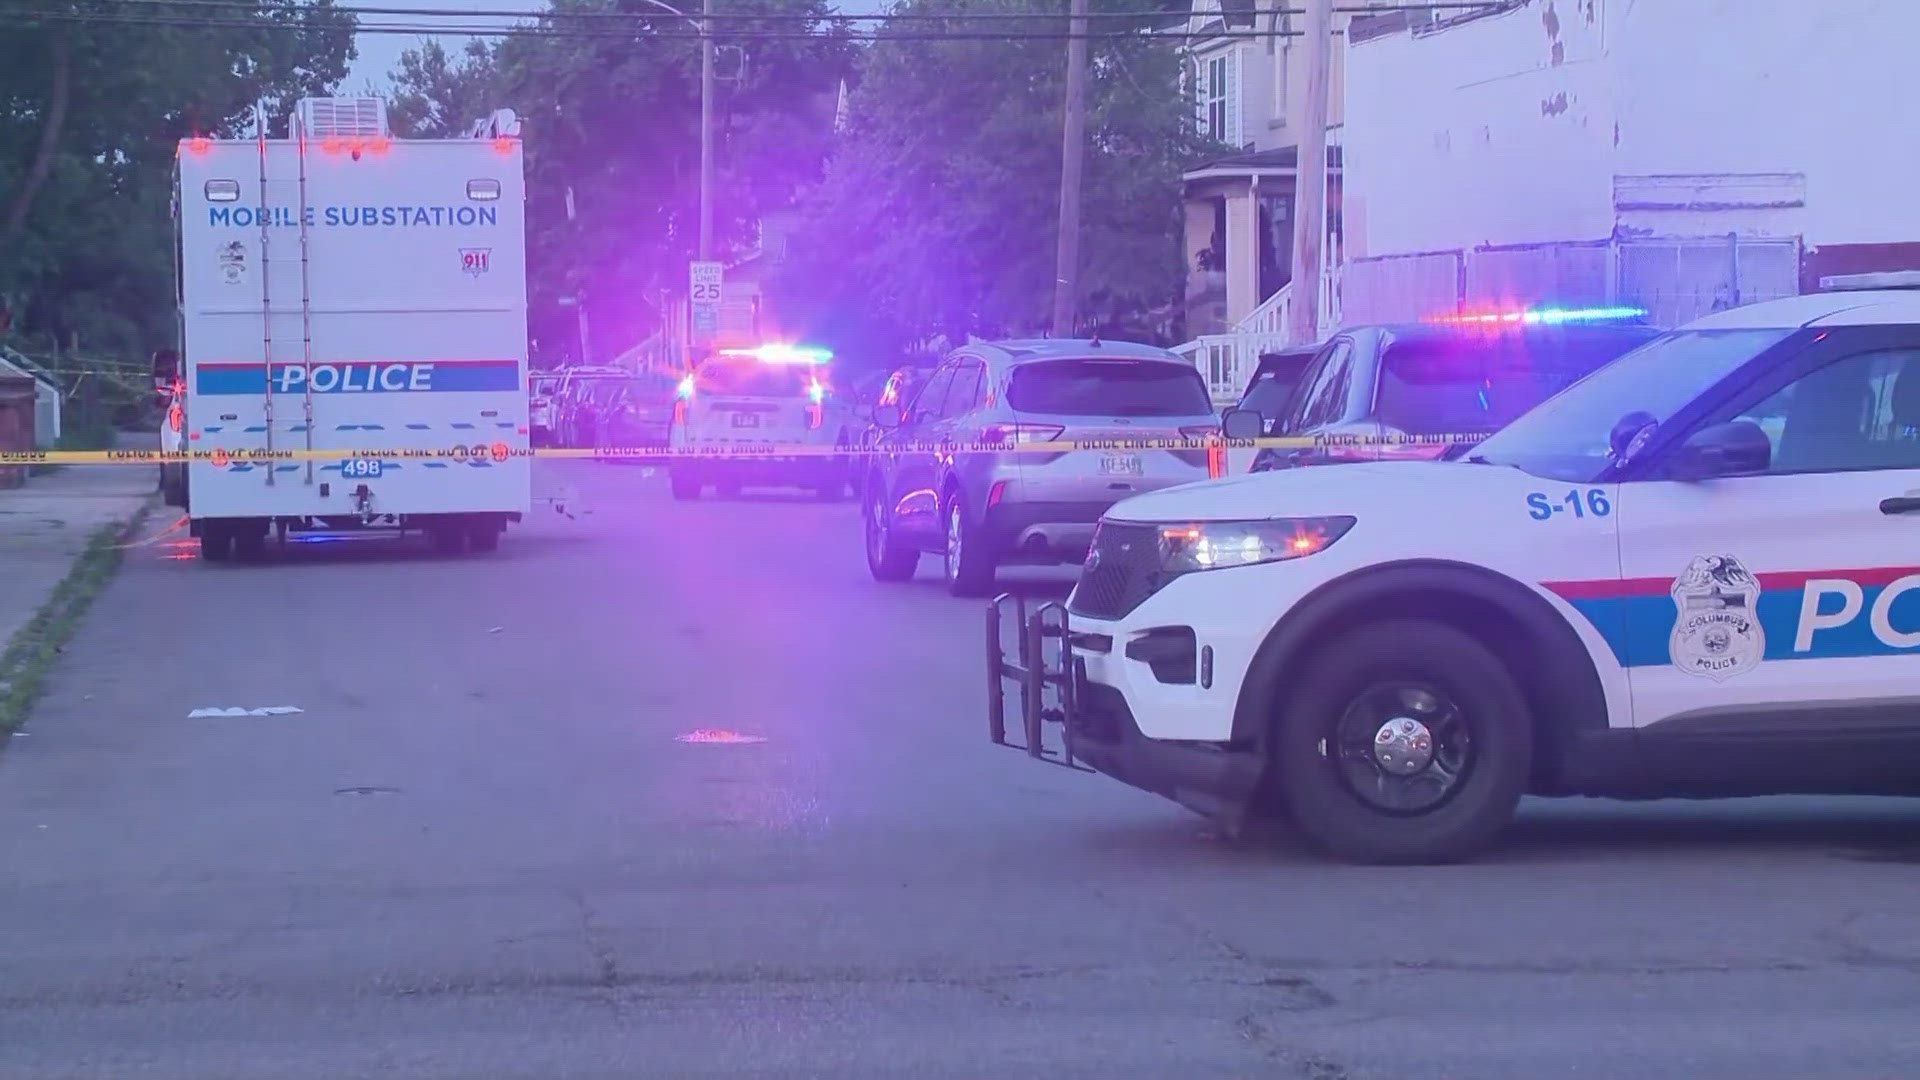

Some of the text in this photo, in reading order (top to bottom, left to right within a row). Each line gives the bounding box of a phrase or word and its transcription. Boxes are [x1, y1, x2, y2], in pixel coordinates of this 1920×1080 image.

[209, 206, 497, 227] MOBILE SUBSTATION
[464, 253, 487, 269] 911
[693, 266, 720, 274] SPEED
[695, 274, 717, 282] LIMIT
[693, 284, 720, 299] 25
[281, 363, 435, 393] POLICE
[1124, 440, 1153, 449] LINE
[344, 460, 380, 476] 498
[1526, 488, 1611, 521] S-16
[1688, 614, 1745, 628] COLUMBUS
[1696, 656, 1738, 671] POLICE
